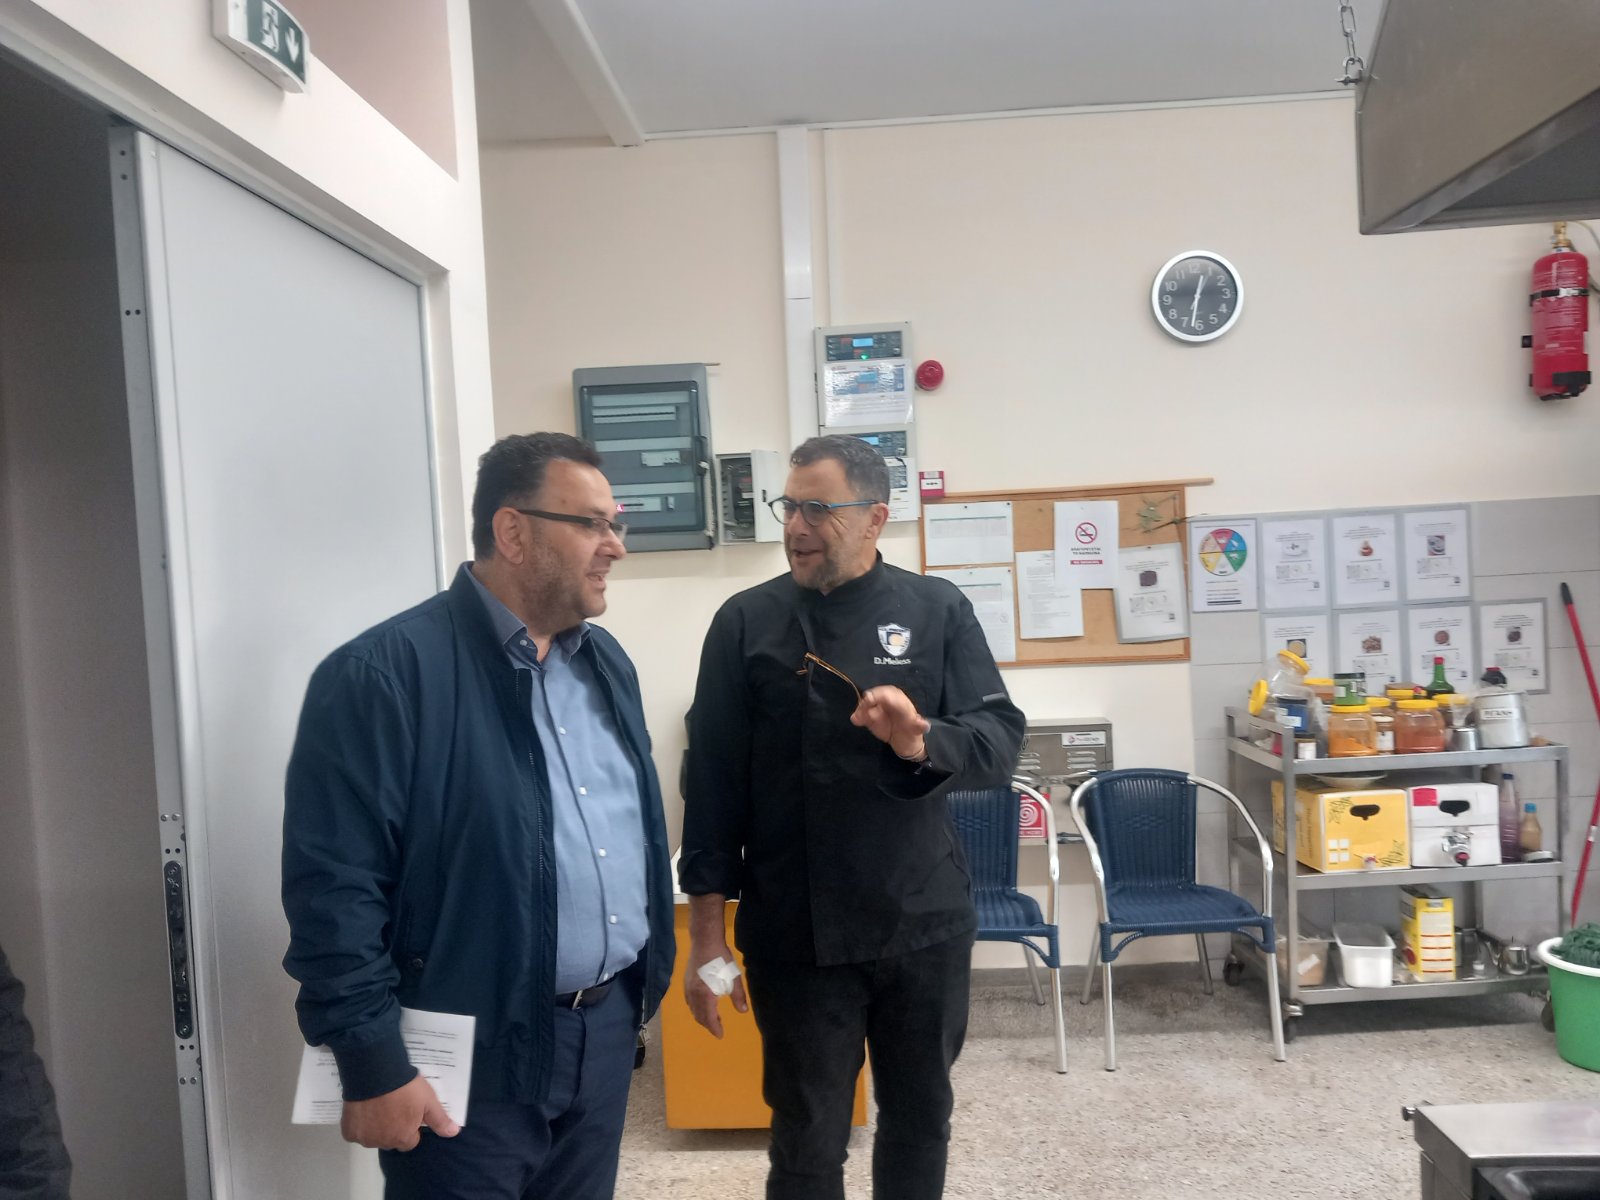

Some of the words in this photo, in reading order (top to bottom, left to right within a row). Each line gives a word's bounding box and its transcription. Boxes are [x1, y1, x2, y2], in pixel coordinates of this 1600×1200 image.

[1208, 266, 1213, 277] 1
[1164, 280, 1178, 292] 10
[1216, 275, 1226, 287] 2
[1221, 288, 1232, 299] 3
[1162, 294, 1173, 306] 9
[1168, 308, 1178, 320] 8
[1218, 303, 1228, 314] 4
[1180, 316, 1190, 328] 7
[1208, 313, 1219, 325] 5
[1194, 320, 1205, 331] 6
